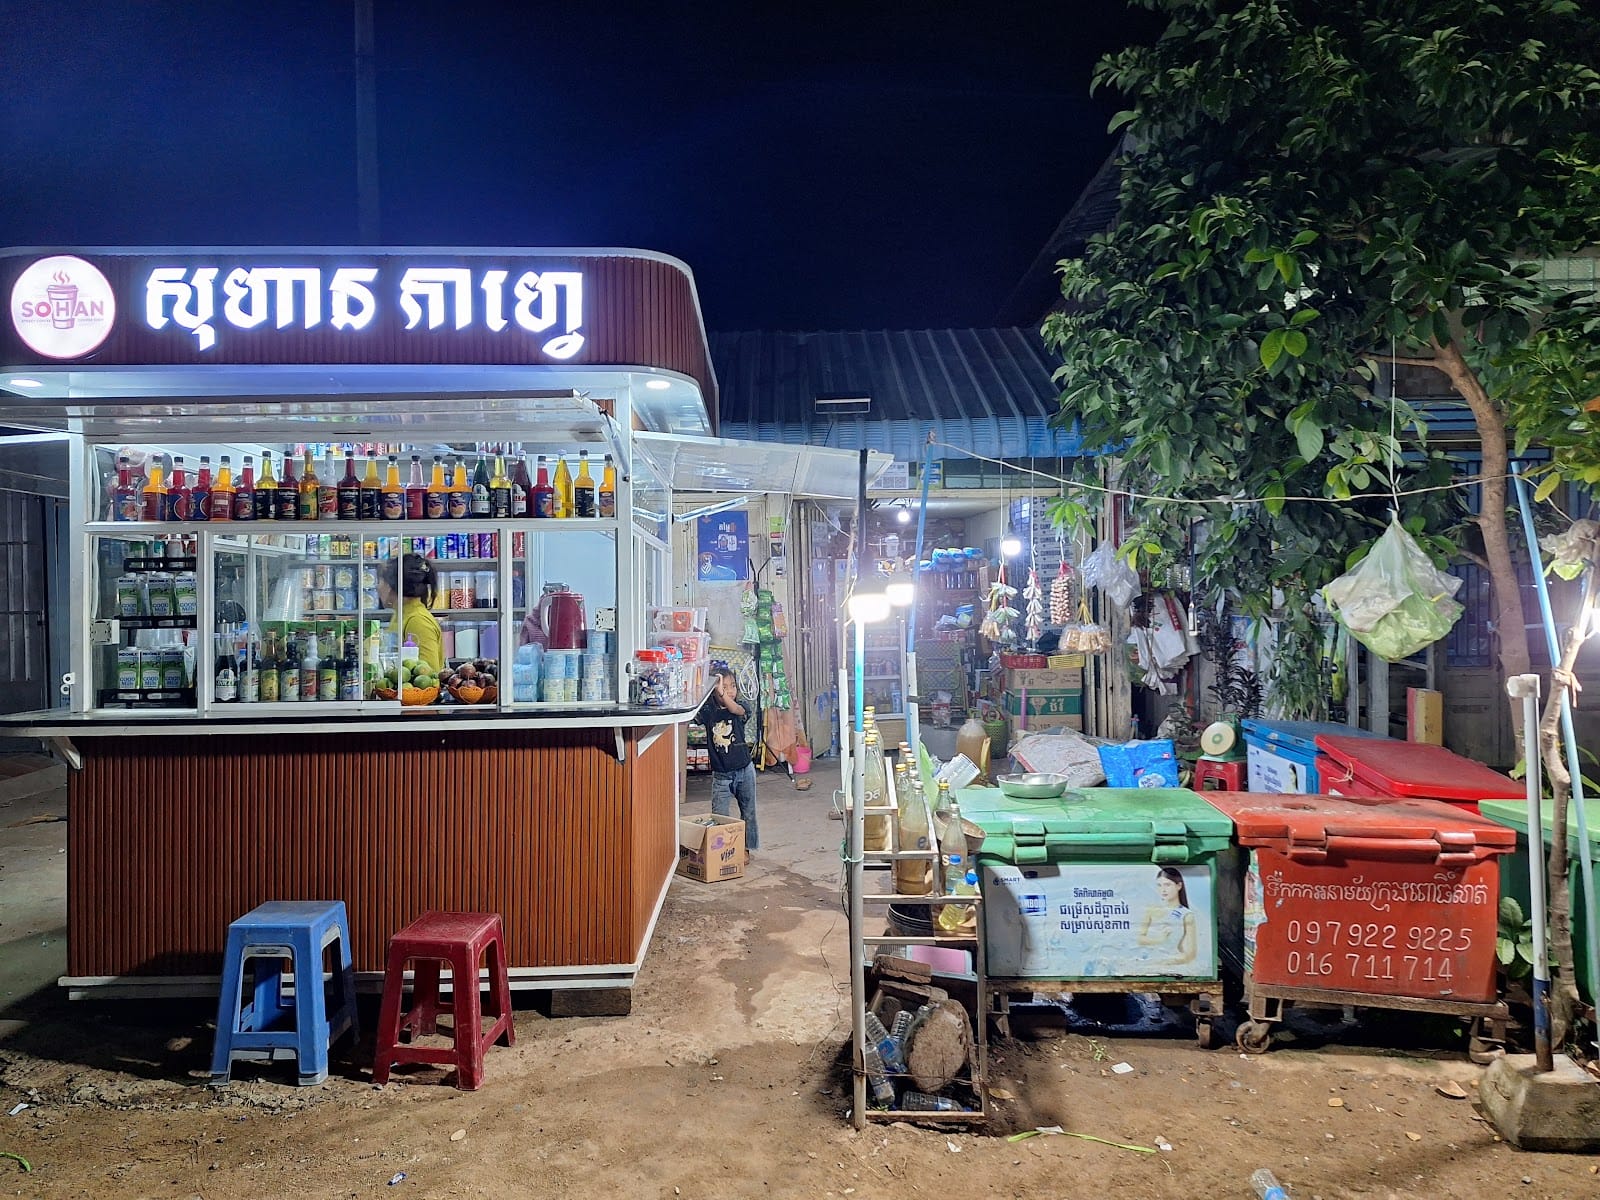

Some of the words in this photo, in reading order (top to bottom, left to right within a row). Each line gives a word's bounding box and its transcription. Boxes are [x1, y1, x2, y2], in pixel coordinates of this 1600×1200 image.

[21, 301, 104, 318] SOHAN
[400, 267, 585, 360] កាហ្វេ
[1286, 920, 1341, 946] 097
[1347, 923, 1397, 949] 922
[1406, 926, 1473, 951] 9225
[1287, 951, 1333, 975] 016
[1345, 953, 1395, 979] 711
[1403, 955, 1453, 982] 714
